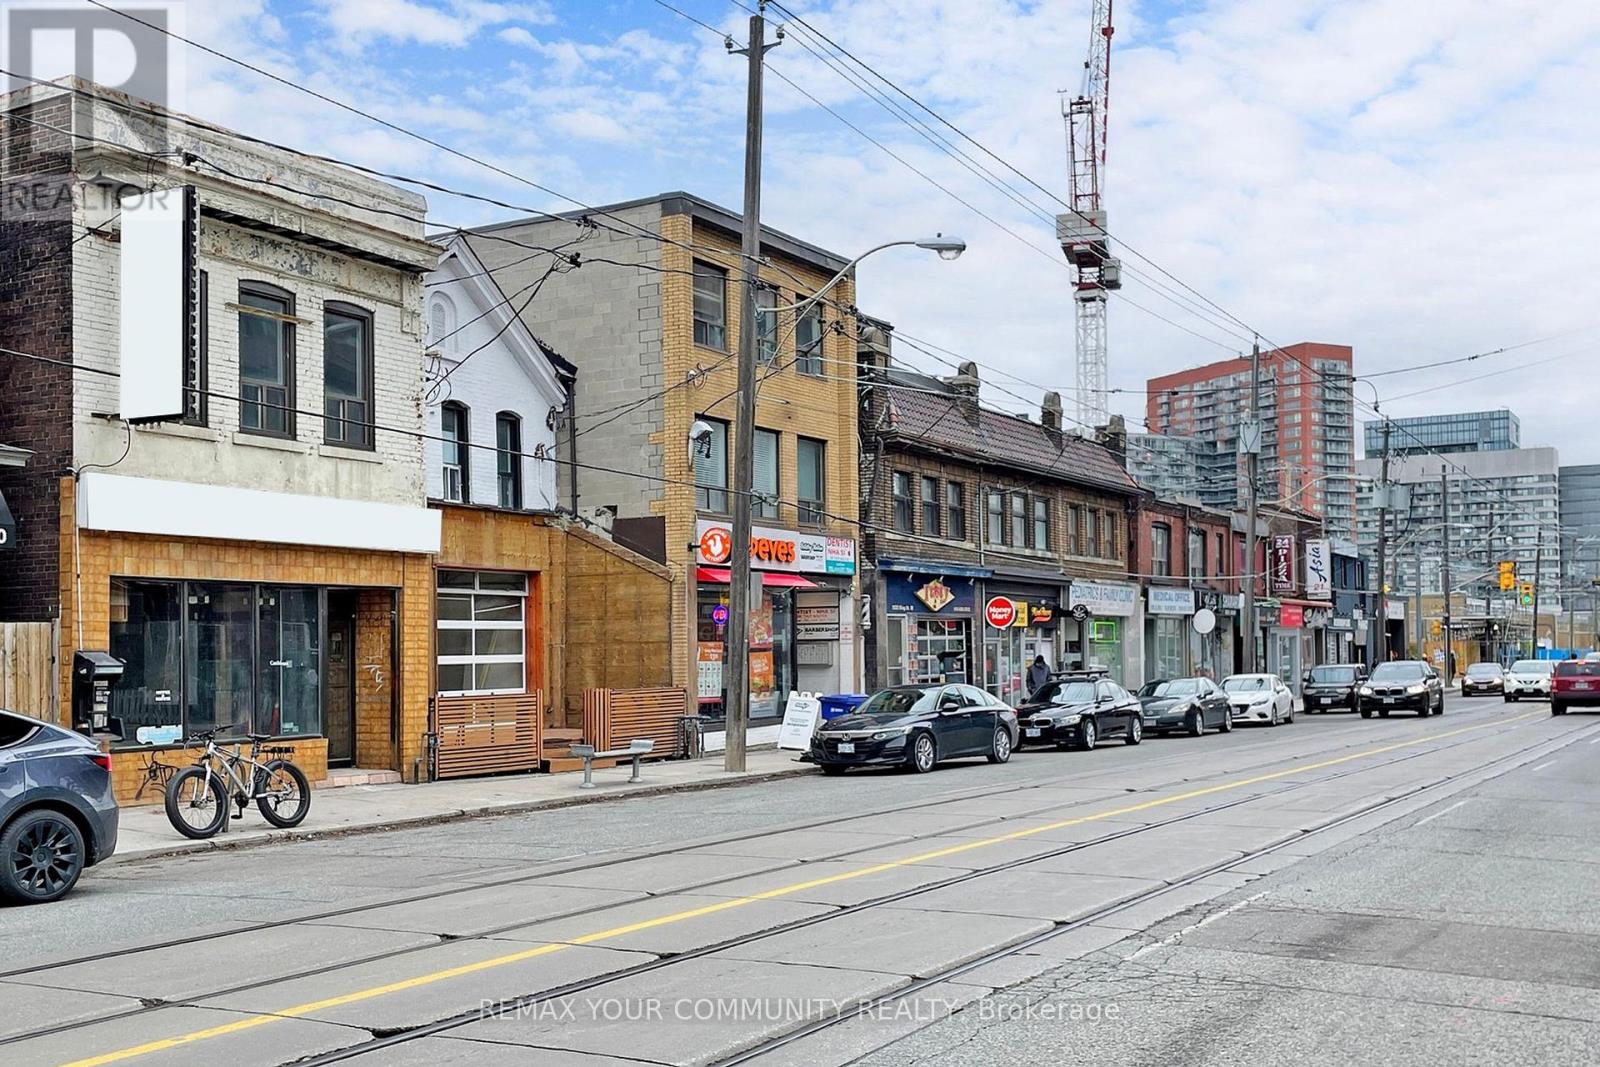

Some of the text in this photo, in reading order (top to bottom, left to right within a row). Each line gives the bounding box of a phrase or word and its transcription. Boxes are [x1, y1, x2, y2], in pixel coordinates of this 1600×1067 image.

[827, 536, 853, 548] DENTIST
[1309, 545, 1327, 583] Asia
[1154, 591, 1190, 602] MEDICAL OFFICE
